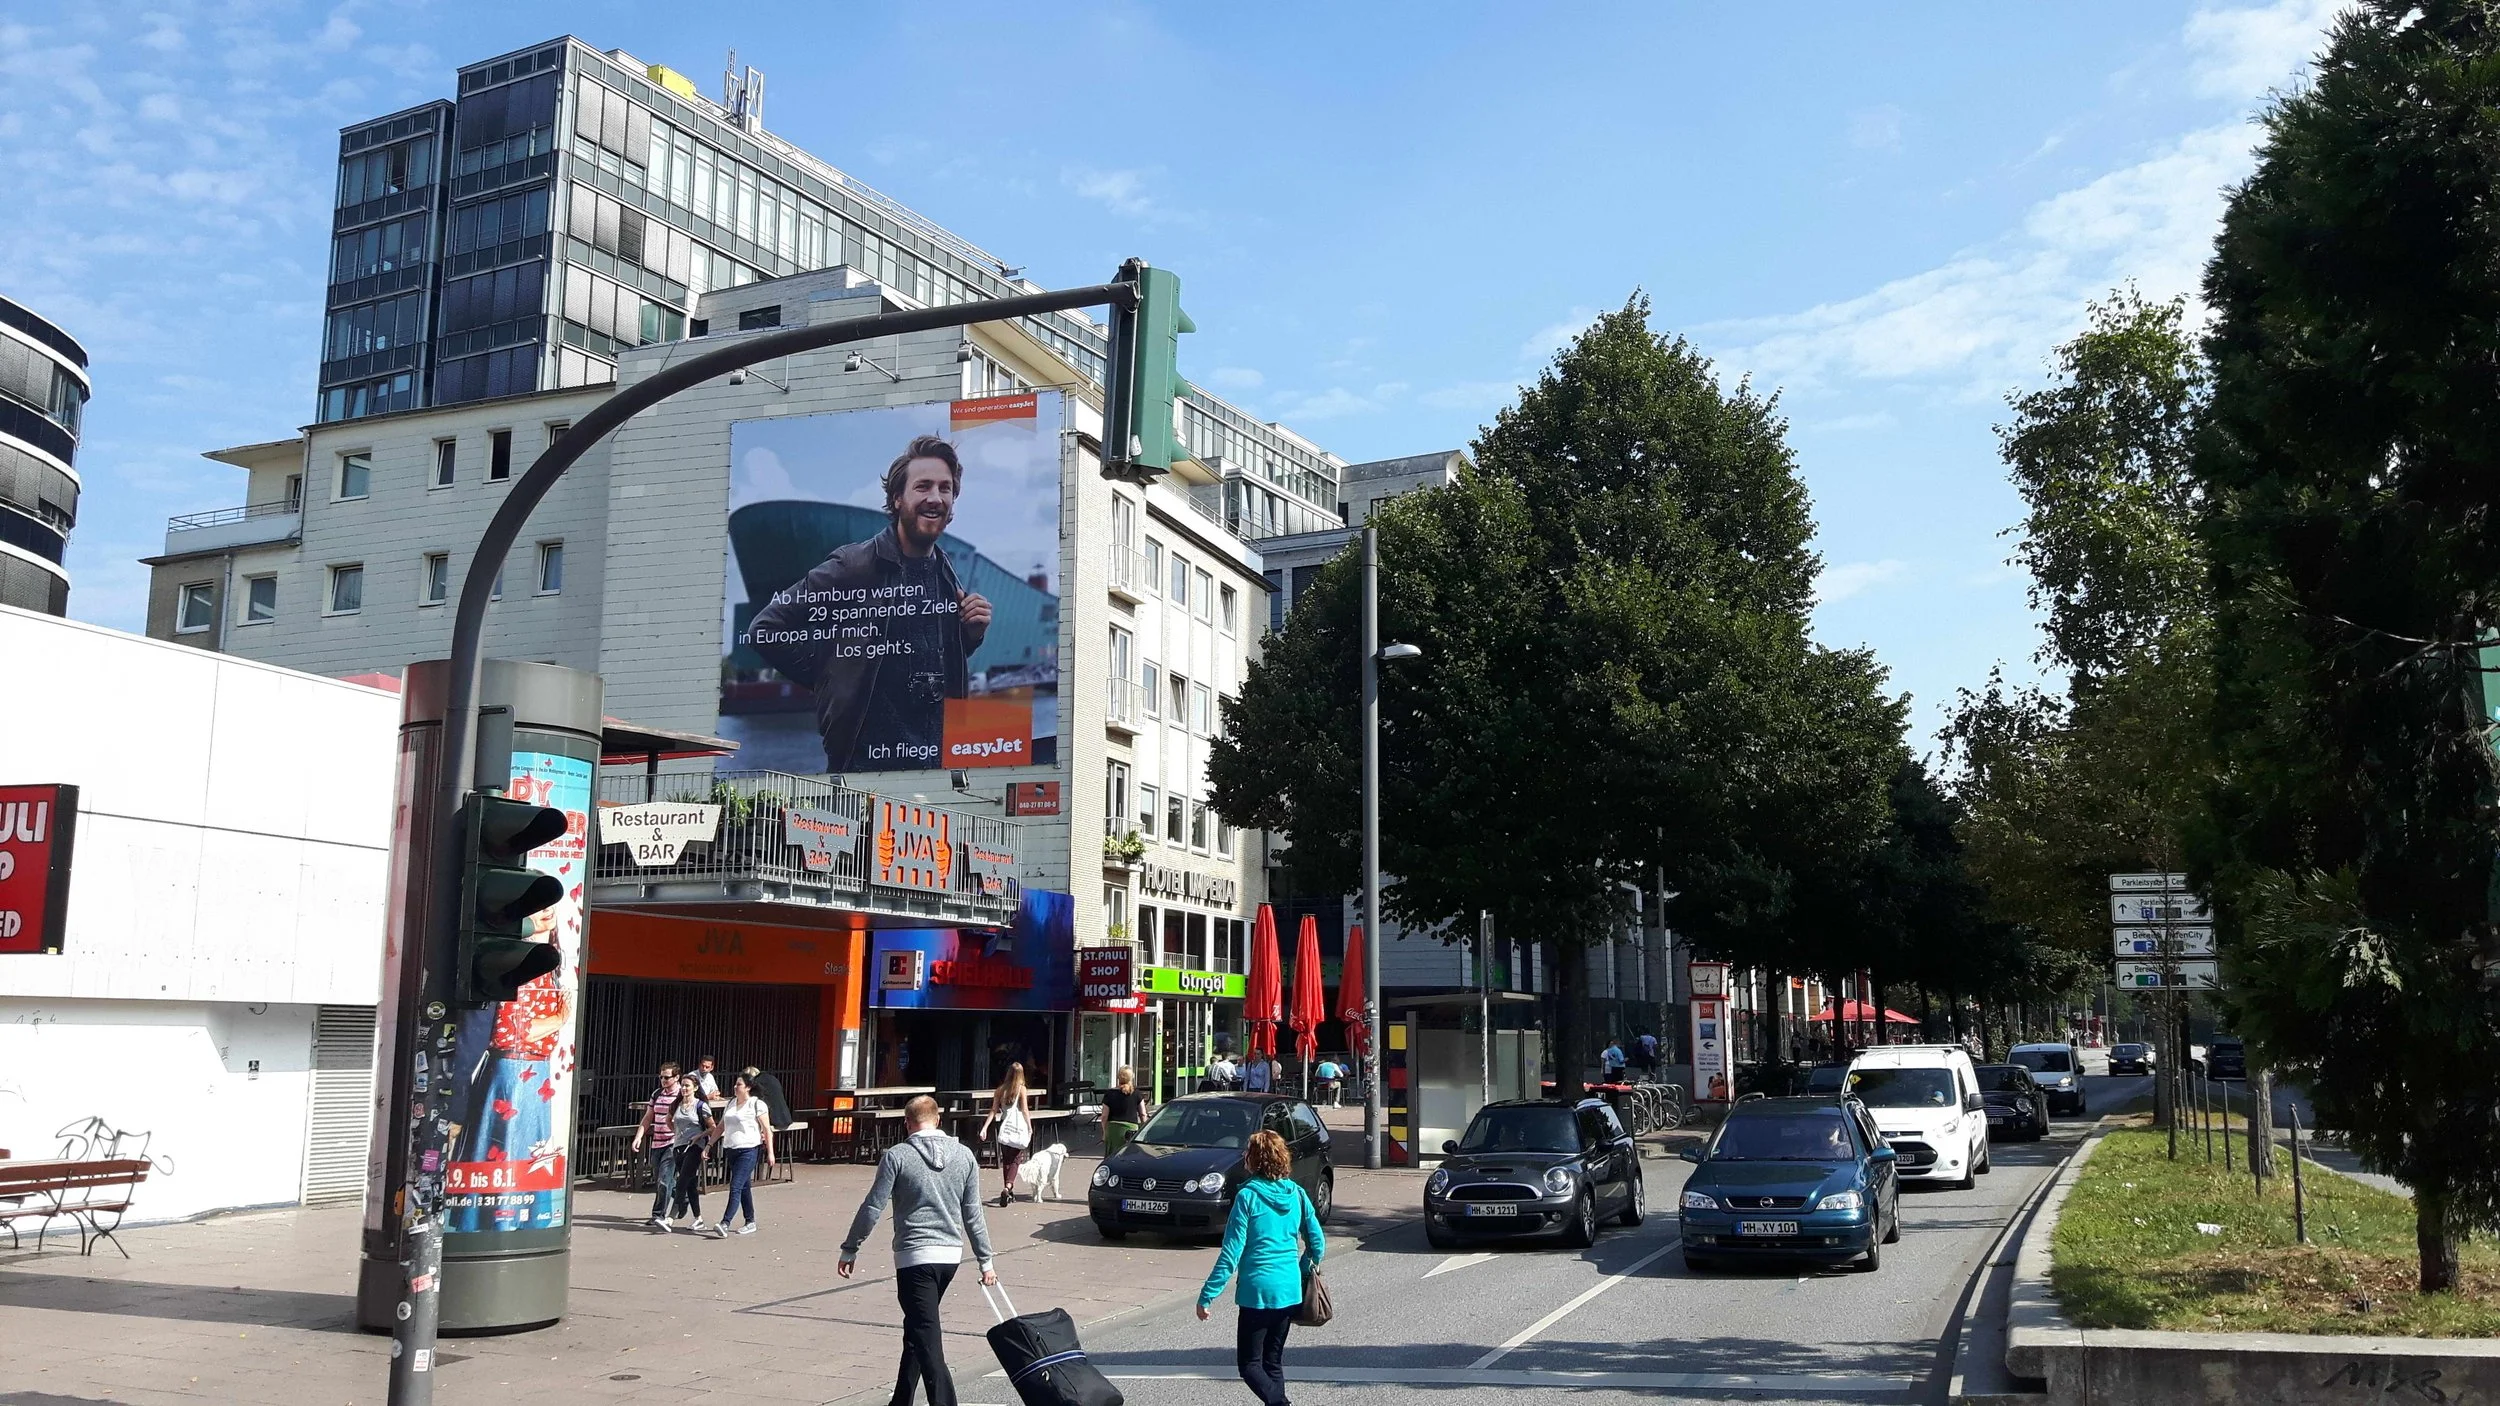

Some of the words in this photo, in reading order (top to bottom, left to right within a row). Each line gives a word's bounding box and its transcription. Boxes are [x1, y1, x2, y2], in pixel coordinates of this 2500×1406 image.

[977, 404, 1009, 412] generation
[1009, 401, 1034, 409] easyJet
[770, 591, 792, 605] Ab
[796, 588, 867, 604] Hamburg
[871, 584, 924, 598] warten
[808, 606, 828, 622] 29
[831, 601, 917, 622] spannende
[921, 600, 958, 615] Ziele
[739, 630, 751, 644] in
[756, 628, 808, 644] Europa
[812, 625, 838, 640] auf
[841, 622, 882, 638] mich.
[836, 643, 862, 658] Los
[866, 640, 915, 659] geht's.
[868, 744, 891, 759] Ich
[896, 742, 939, 760] fliege
[951, 738, 1023, 757] easyJet
[503, 778, 553, 804] DY
[612, 809, 705, 827] Restaurant
[793, 813, 850, 837] Restaurant
[652, 827, 663, 842] &
[638, 844, 675, 860] BAR
[898, 831, 935, 863] JVA
[974, 846, 1015, 865] Restaurant
[808, 850, 832, 867] BAR
[1145, 863, 1185, 895] HOTEL
[1189, 871, 1238, 904] IMPERIAL
[1091, 967, 1119, 976] SHOP
[1084, 984, 1125, 997] KIOSK
[1181, 971, 1225, 994] bingöl
[470, 1172, 488, 1188] bis
[493, 1168, 516, 1187] 8.1.
[497, 1196, 508, 1205] 77
[510, 1195, 523, 1205] 88
[523, 1195, 535, 1204] 99
[1148, 1203, 1168, 1211] 1265
[1763, 1223, 1775, 1233] XY
[1778, 1223, 1797, 1233] 101
